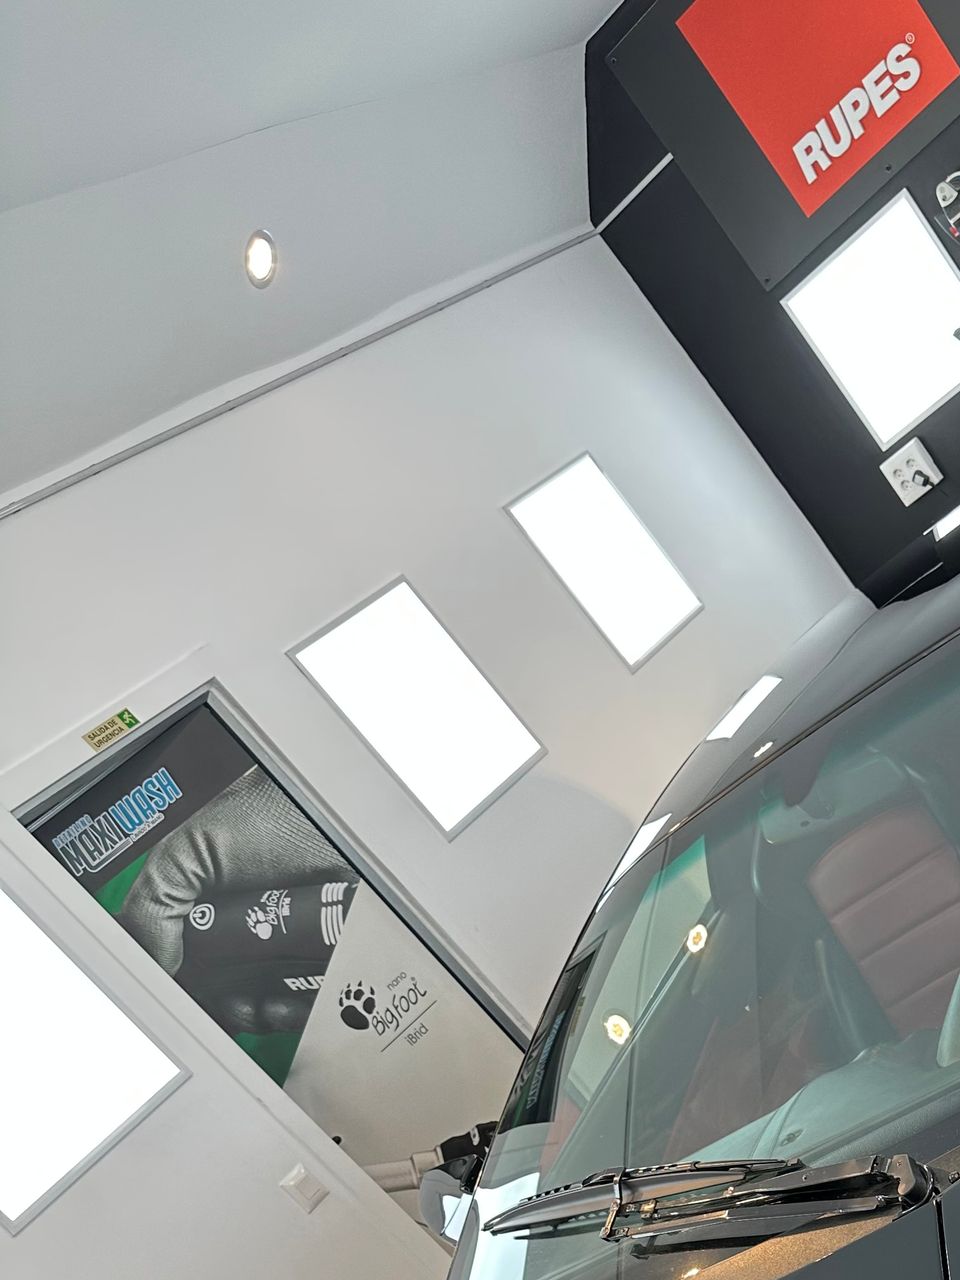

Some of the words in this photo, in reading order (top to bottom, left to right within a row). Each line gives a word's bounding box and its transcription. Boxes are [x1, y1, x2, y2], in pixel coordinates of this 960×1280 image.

[792, 43, 921, 185] RUPES
[88, 724, 111, 741] SALIDA
[107, 719, 118, 728] DE
[93, 726, 124, 748] URGENCIA
[58, 811, 127, 877] MAXI
[108, 767, 183, 834] WASH
[387, 971, 407, 991] nano
[404, 1022, 429, 1046] iBrid
